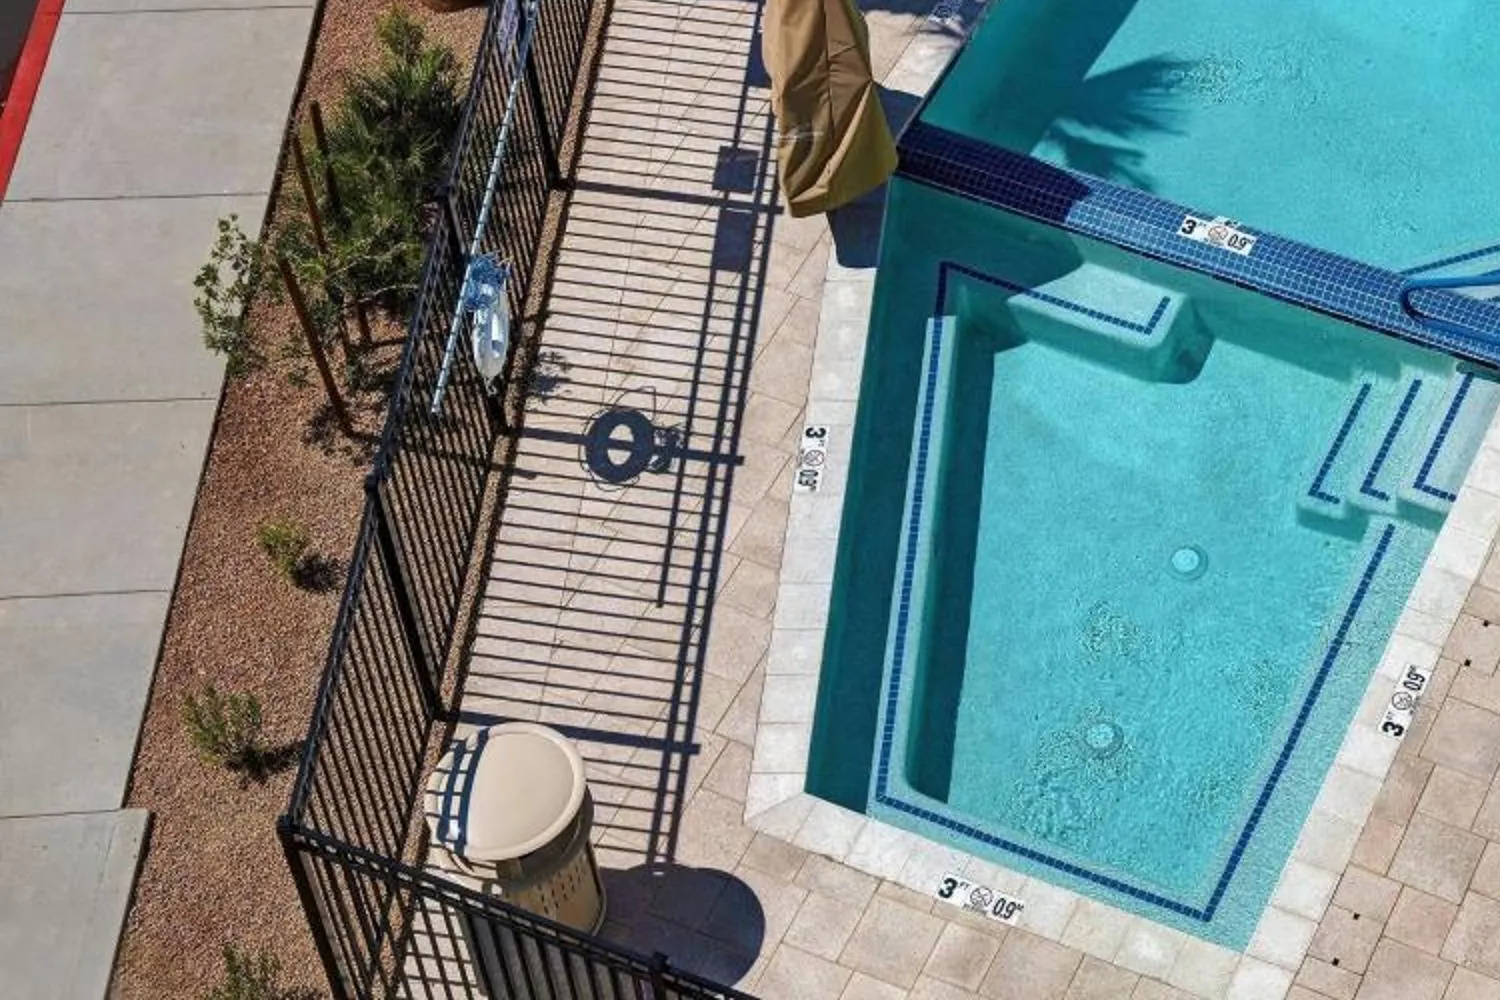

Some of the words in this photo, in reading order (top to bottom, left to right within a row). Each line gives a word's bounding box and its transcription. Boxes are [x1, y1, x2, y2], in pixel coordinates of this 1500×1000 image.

[1181, 219, 1197, 235] 3
[805, 427, 827, 438] 3
[1382, 721, 1405, 737] 3
[938, 877, 959, 899] 3
